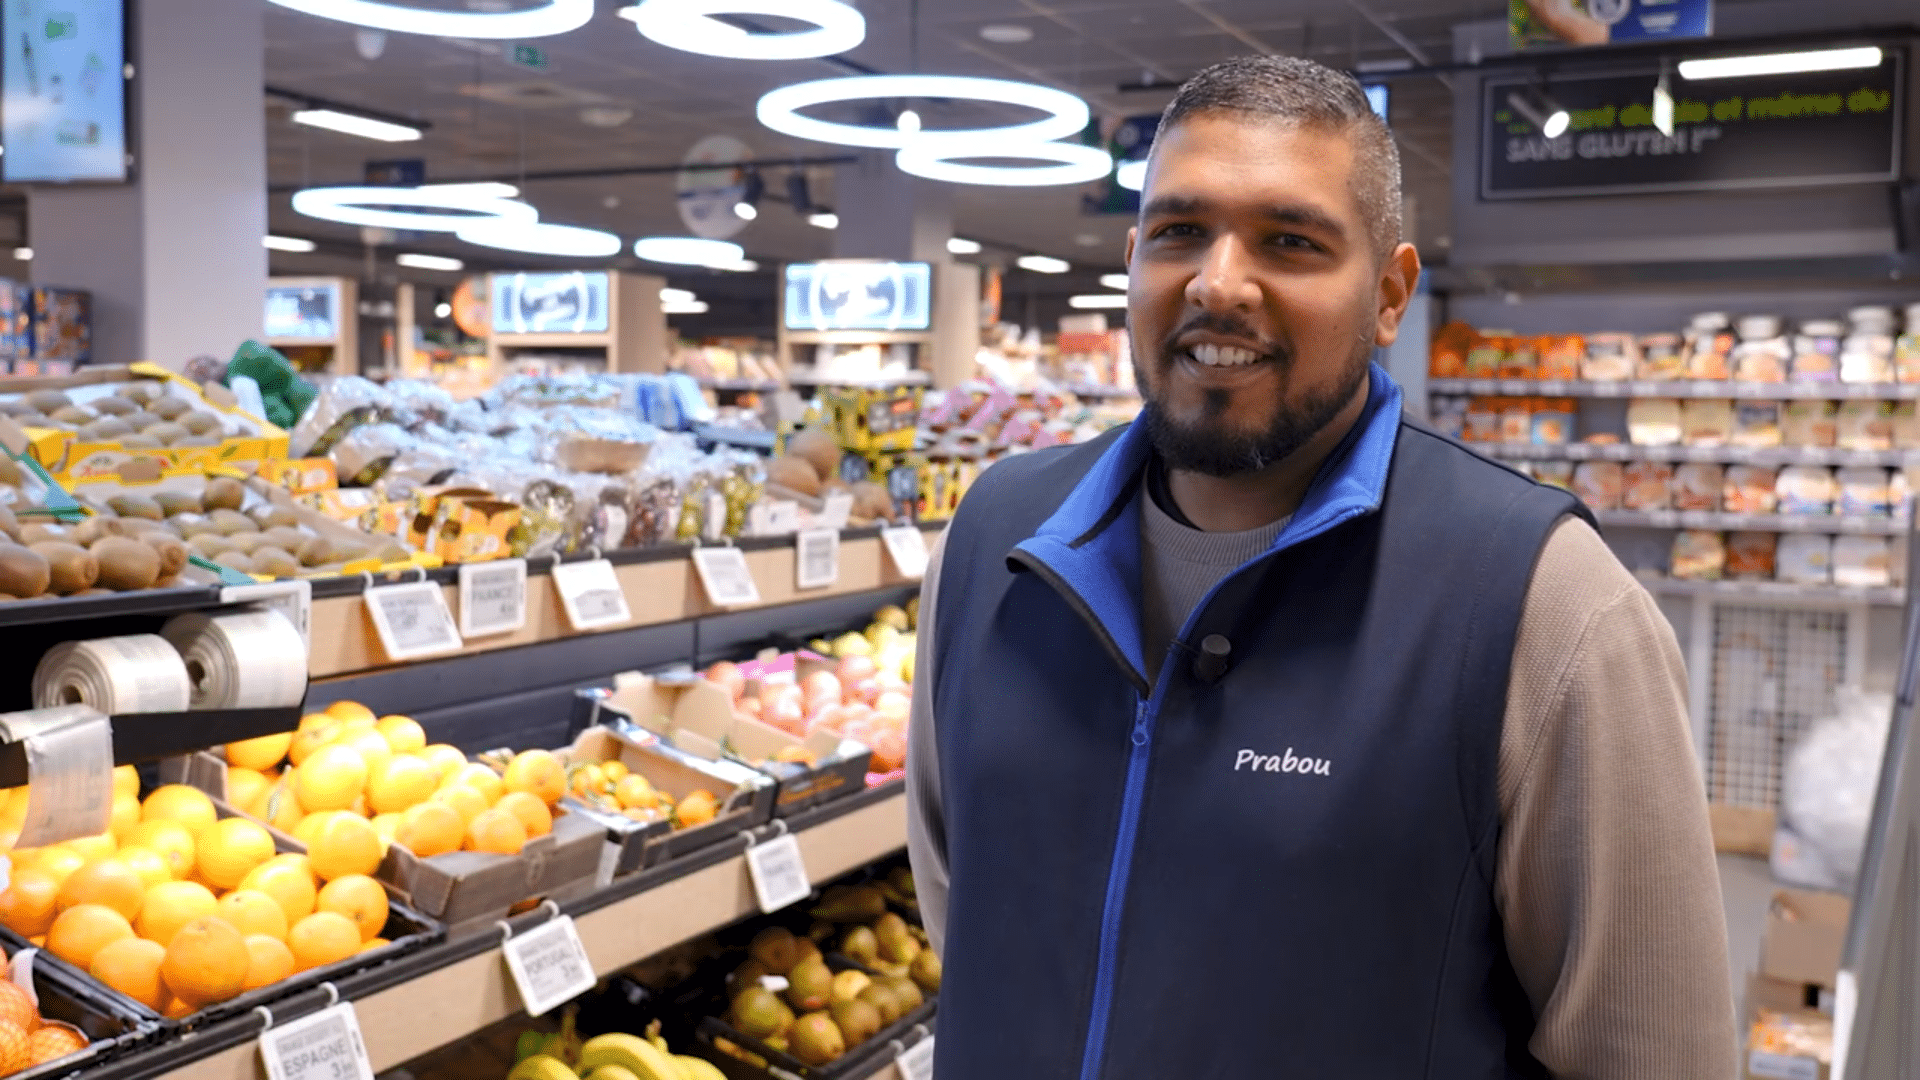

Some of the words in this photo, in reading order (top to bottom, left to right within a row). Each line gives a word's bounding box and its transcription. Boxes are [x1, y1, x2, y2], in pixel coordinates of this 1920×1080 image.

[1847, 88, 1891, 113] du
[1506, 134, 1574, 162] SANS
[1578, 129, 1688, 159] GLUTEN
[1234, 746, 1331, 776] Prabou
[283, 1037, 348, 1077] ESPAGNE
